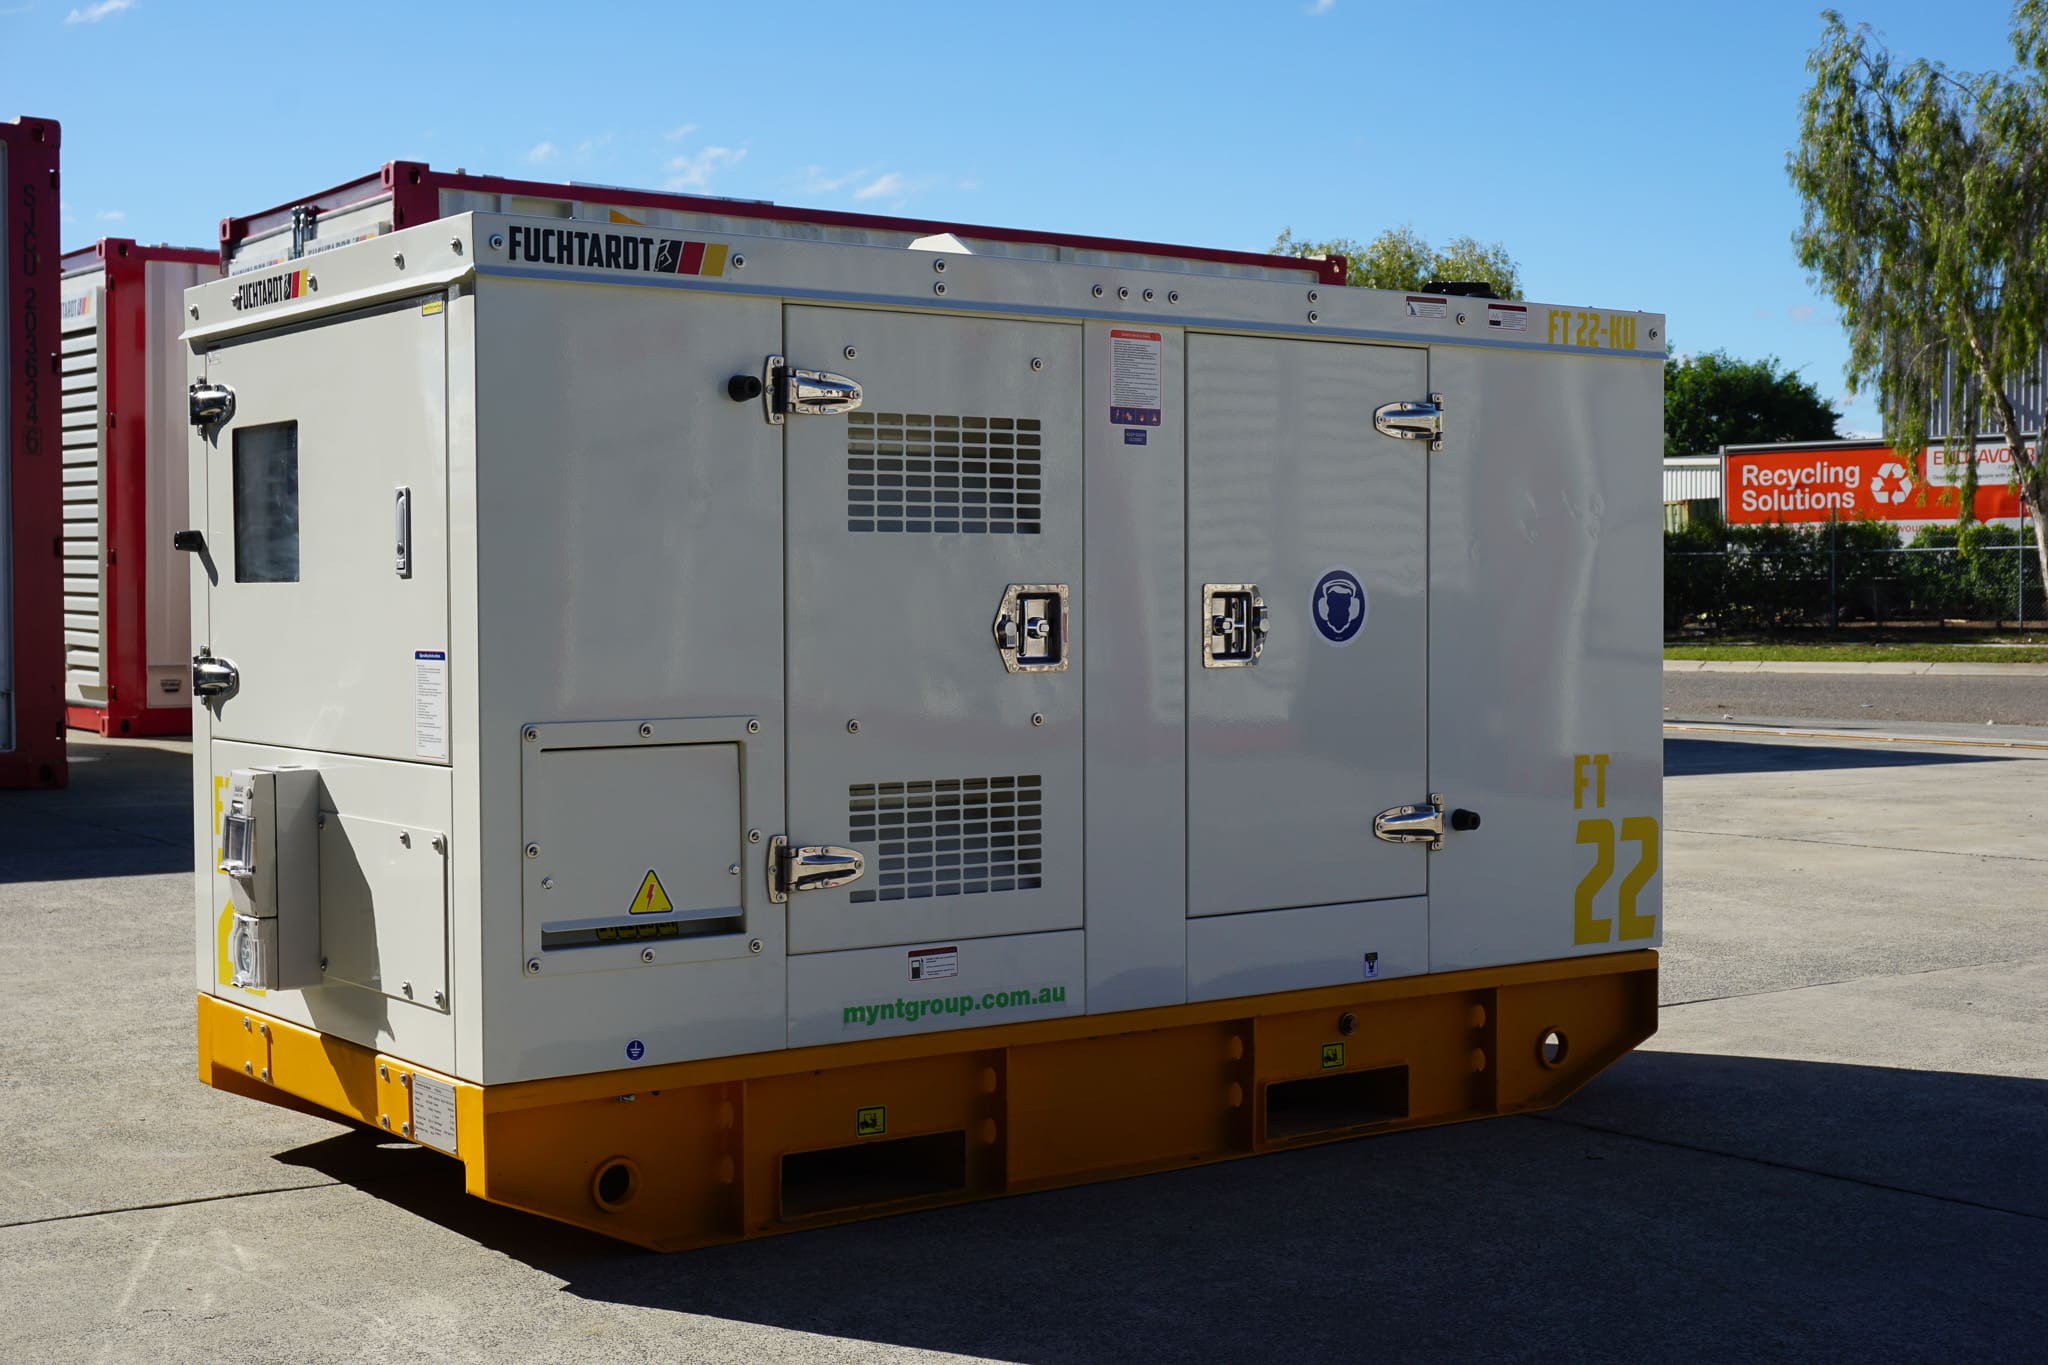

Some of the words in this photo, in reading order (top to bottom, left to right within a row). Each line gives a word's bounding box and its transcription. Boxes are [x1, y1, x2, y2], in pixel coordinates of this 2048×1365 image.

[509, 226, 655, 271] FUCHTARDT
[238, 275, 283, 311] FUCHTARDT
[1548, 309, 1572, 345] FT
[1577, 313, 1636, 350] 22-KU
[1742, 461, 1860, 491] Recycling
[1742, 487, 1856, 512] Solutions
[1573, 754, 1610, 809] FT
[1574, 816, 1659, 945] 22
[843, 985, 1066, 1025] myntgroup.com.au
